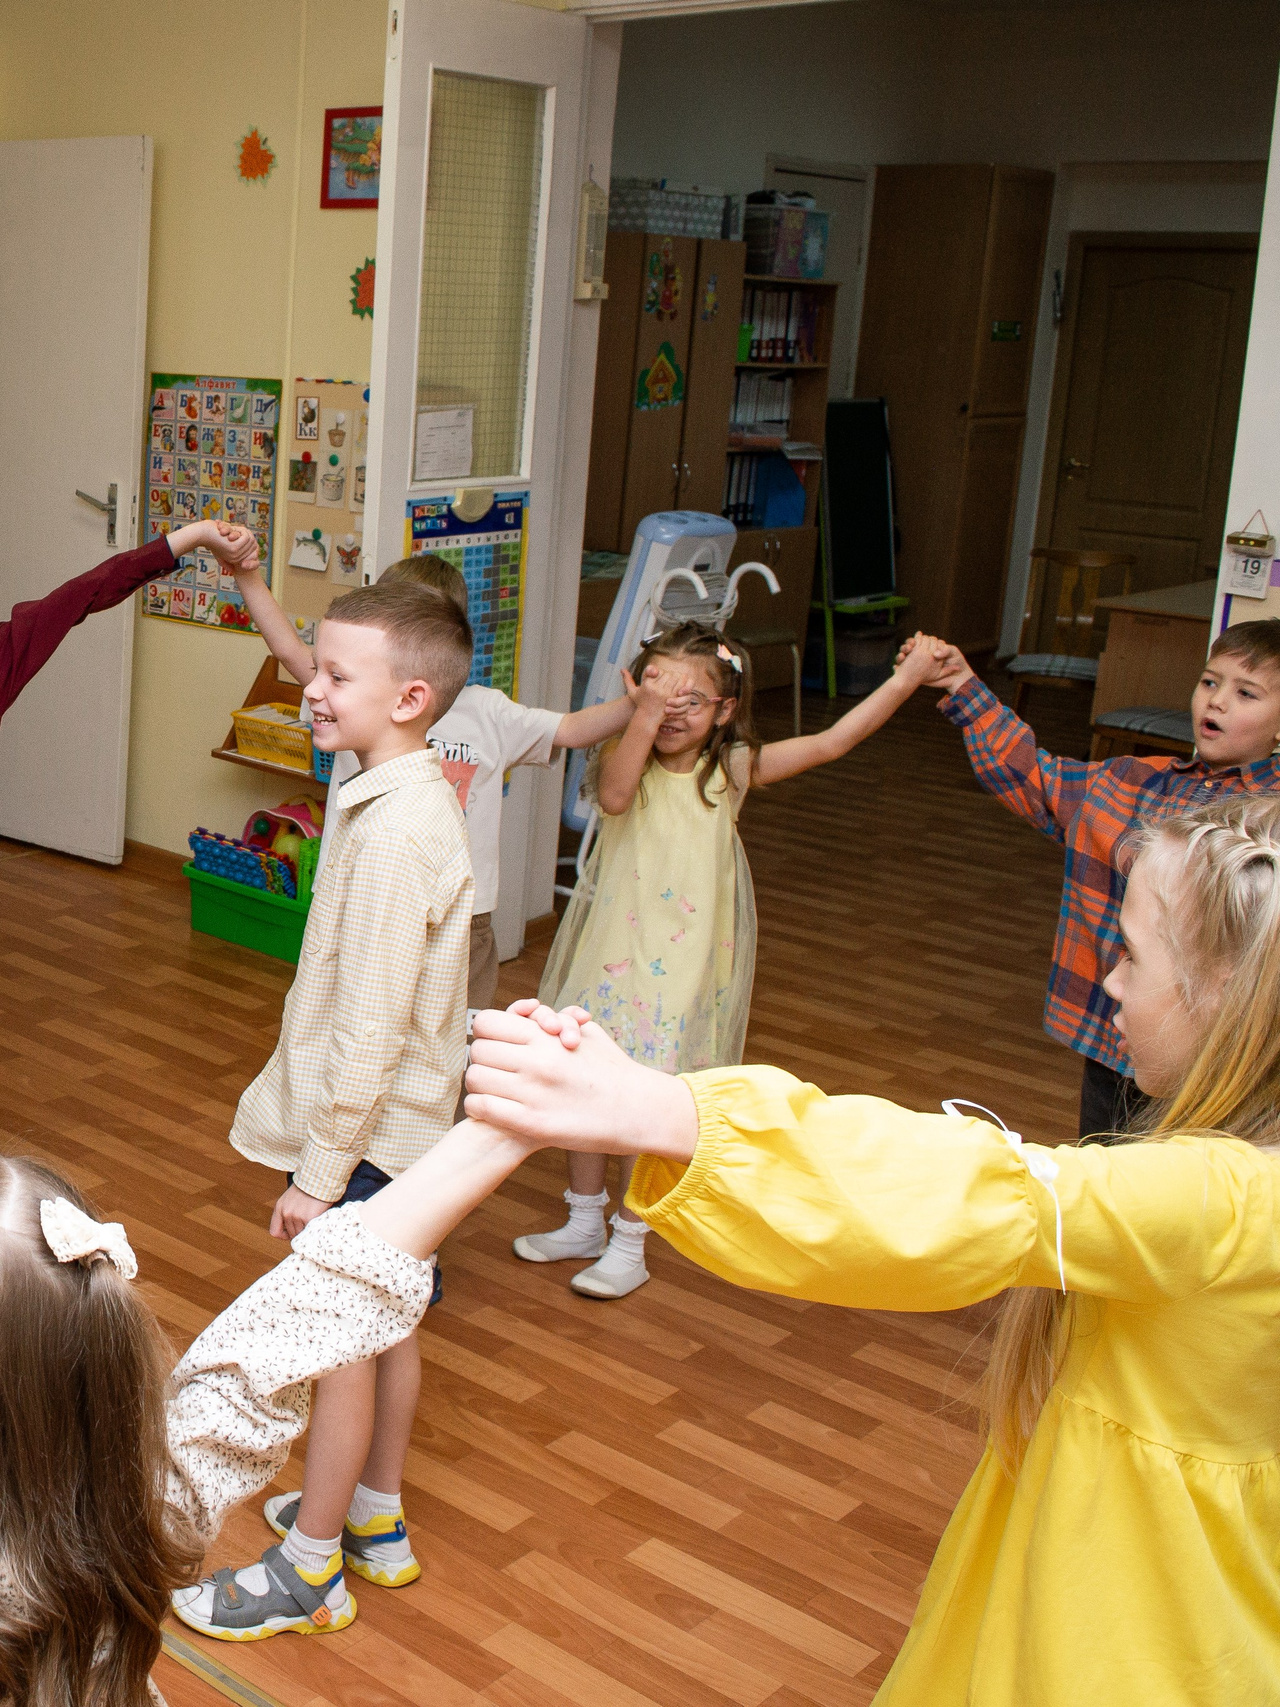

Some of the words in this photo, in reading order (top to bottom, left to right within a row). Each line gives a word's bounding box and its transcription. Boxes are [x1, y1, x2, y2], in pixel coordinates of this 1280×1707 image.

[195, 378, 236, 390] Алфавит
[156, 393, 164, 406] А
[180, 394, 188, 408] Б
[206, 396, 214, 410] В
[230, 398, 238, 410] Г
[255, 398, 264, 414] Д
[153, 424, 160, 438] Е
[202, 428, 214, 441] Ж
[228, 430, 236, 443] З
[254, 432, 263, 446] И
[298, 422, 317, 438] Кк
[178, 458, 187, 472] К
[202, 460, 213, 474] Л
[227, 463, 238, 477] М
[252, 465, 260, 479] Н
[150, 489, 160, 502] О
[176, 492, 185, 504] П
[202, 494, 210, 507] Р
[226, 497, 234, 510] С
[250, 500, 258, 513] Т
[150, 522, 160, 534] У
[414, 519, 448, 531] ЧИТАТЬ
[199, 559, 208, 573] Ъ
[1242, 558, 1262, 575] 19
[149, 585, 158, 597] Э
[173, 589, 184, 602] Ю
[198, 592, 206, 606] Я
